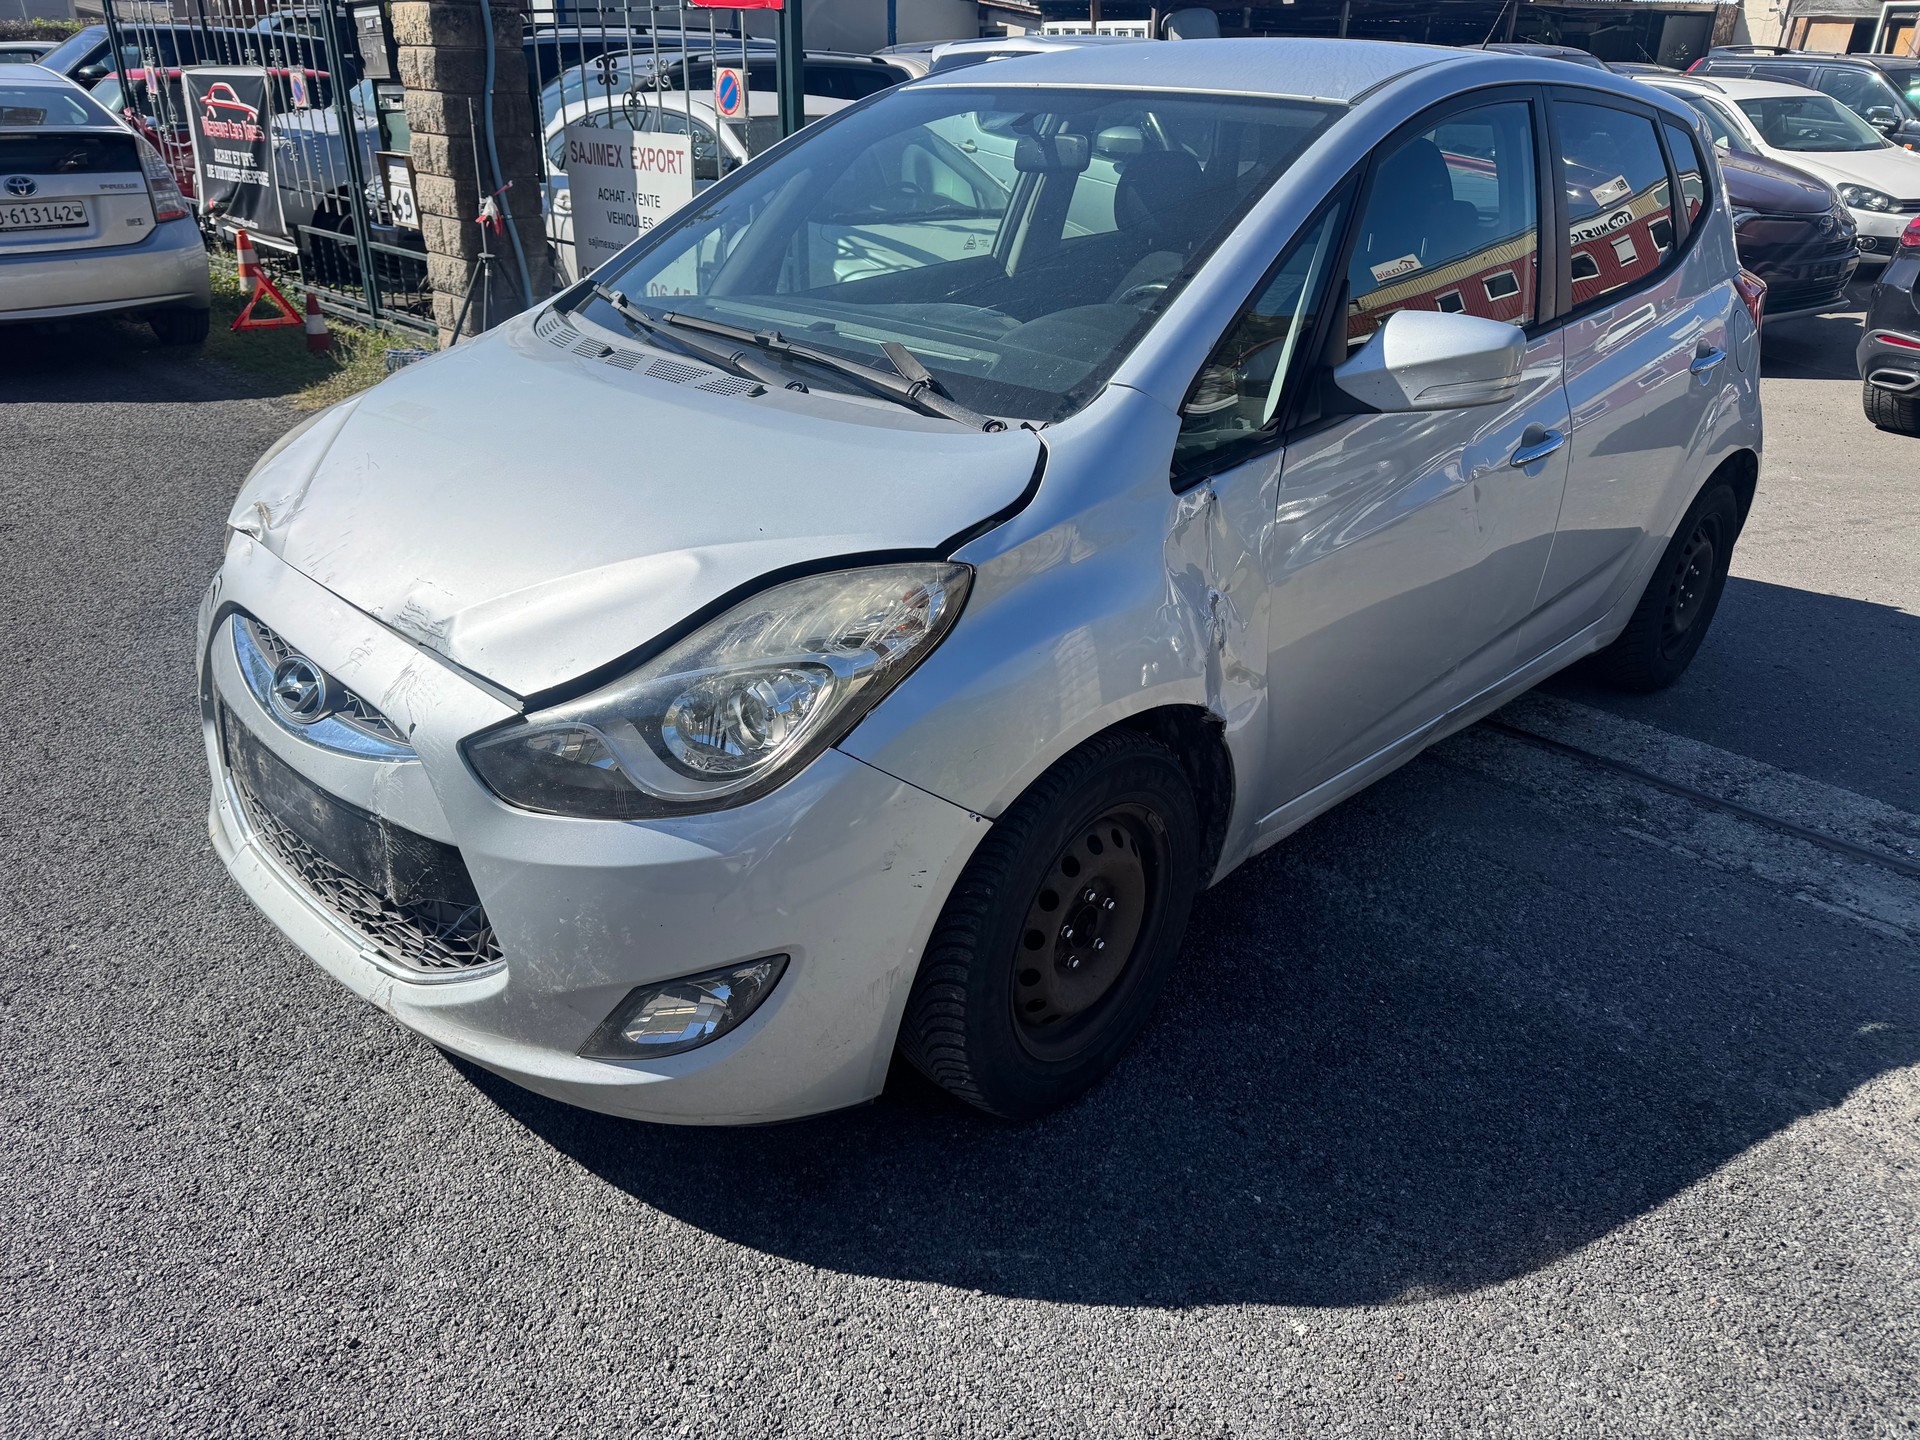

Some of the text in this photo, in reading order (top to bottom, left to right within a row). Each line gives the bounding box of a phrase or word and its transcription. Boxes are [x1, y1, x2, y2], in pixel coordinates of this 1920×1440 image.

[570, 140, 685, 175] SAJIMEX EXPORT
[598, 187, 625, 203] ACHAT
[631, 192, 661, 209] VENTE
[606, 210, 655, 230] VEHICULES
